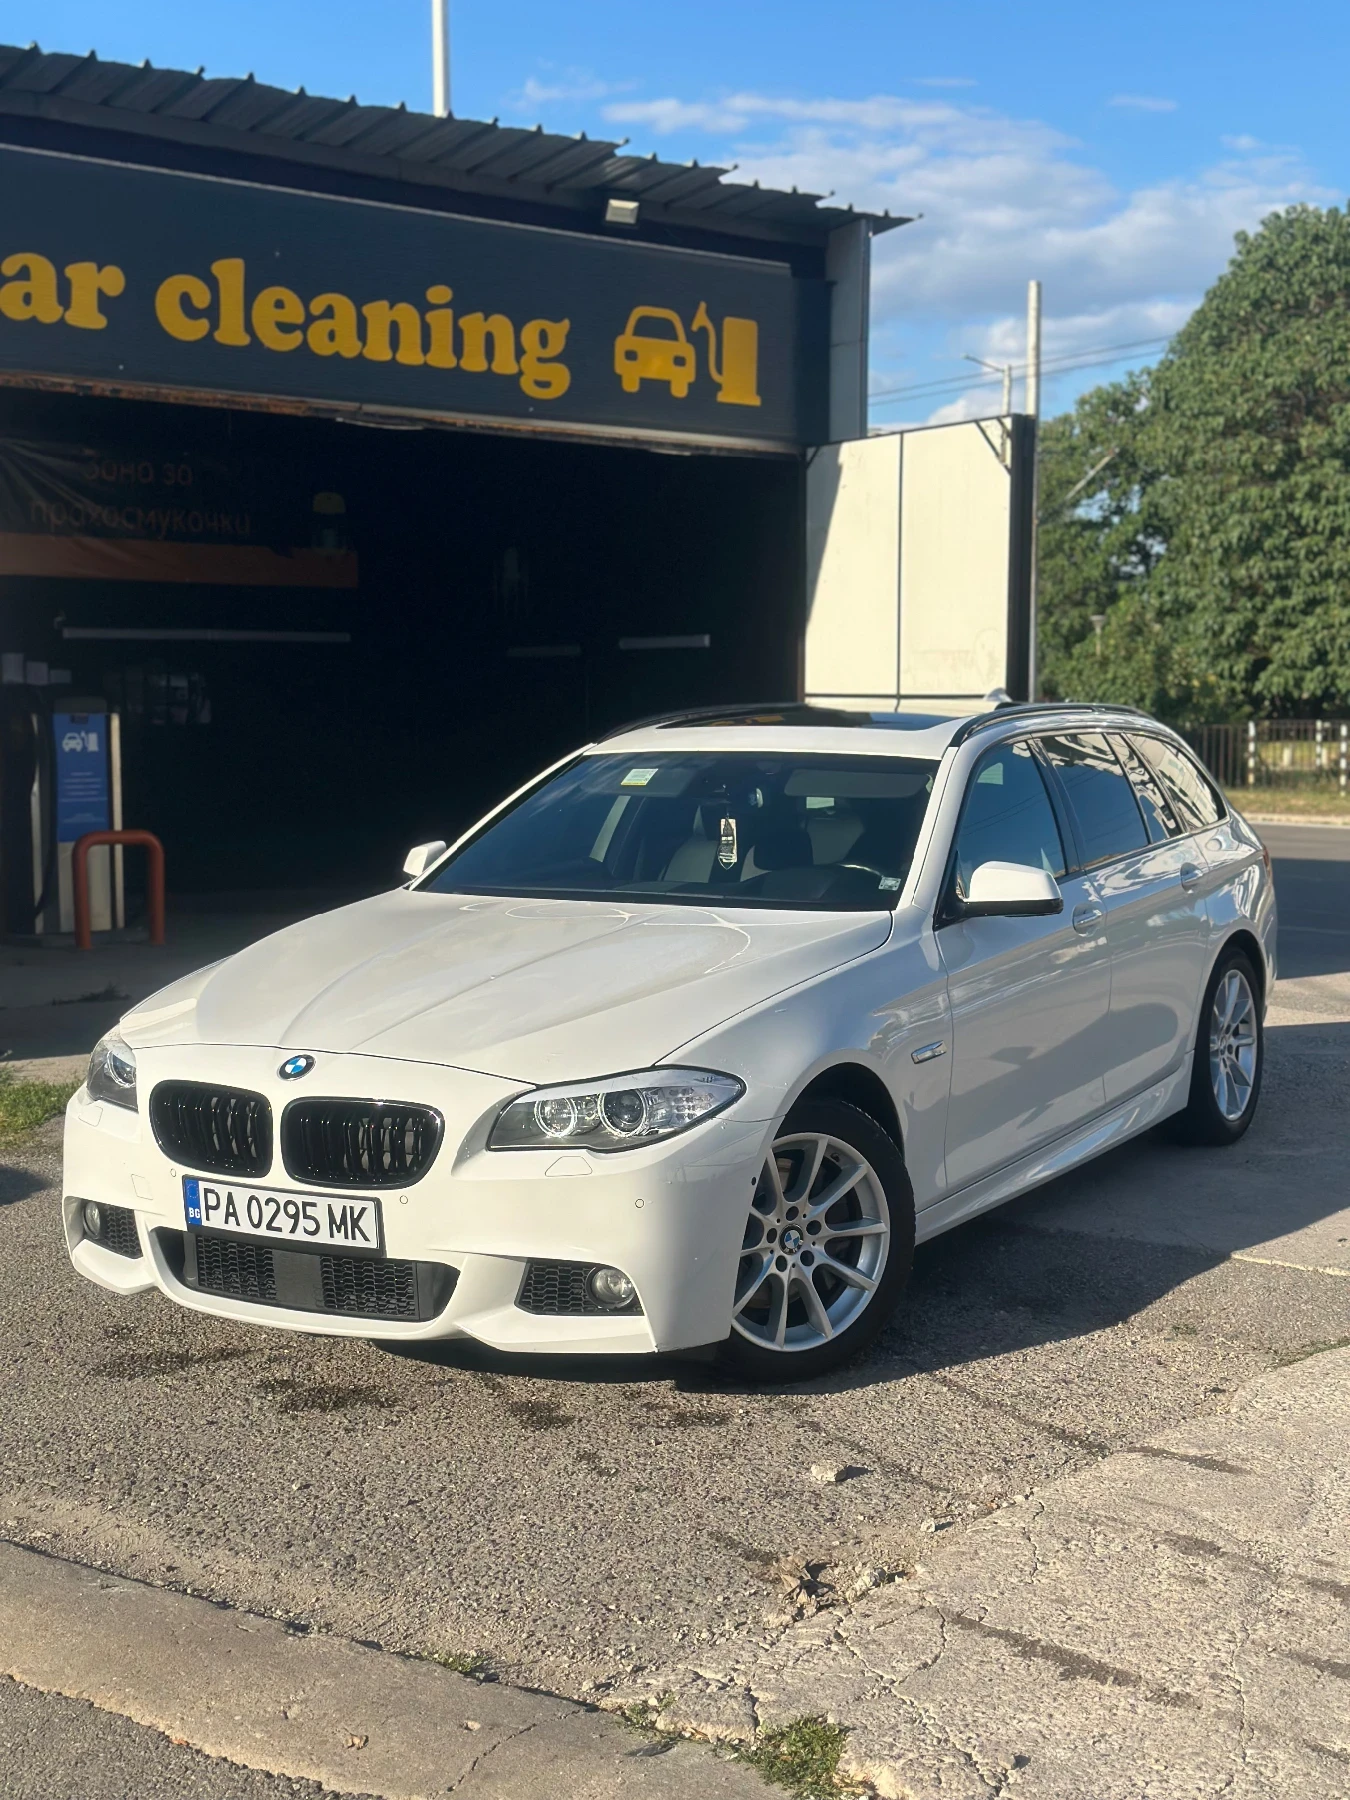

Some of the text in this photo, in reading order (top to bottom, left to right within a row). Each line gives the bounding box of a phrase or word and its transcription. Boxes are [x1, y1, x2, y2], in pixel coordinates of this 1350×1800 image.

[155, 257, 570, 399] cleaning
[188, 1207, 201, 1219] BG
[203, 1187, 371, 1242] PA 0295 MK
